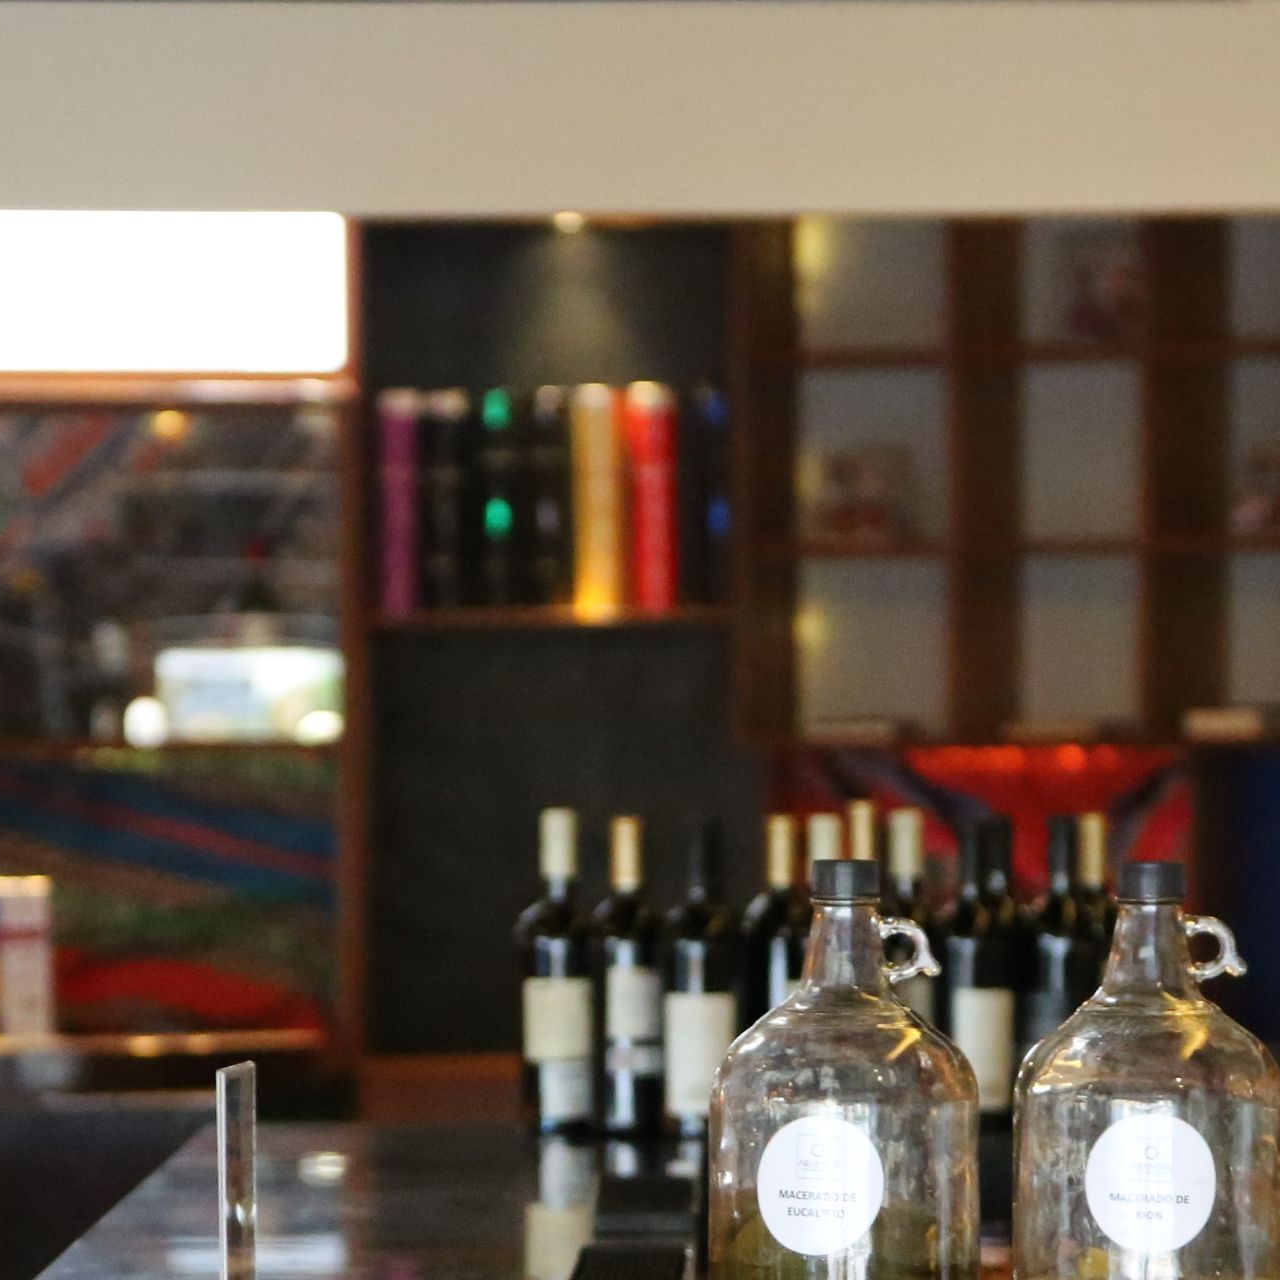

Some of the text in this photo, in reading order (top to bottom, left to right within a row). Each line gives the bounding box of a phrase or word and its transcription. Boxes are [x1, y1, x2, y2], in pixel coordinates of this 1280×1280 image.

[779, 1189, 857, 1202] MACERADO DE
[1109, 1193, 1190, 1204] MACERADO DE
